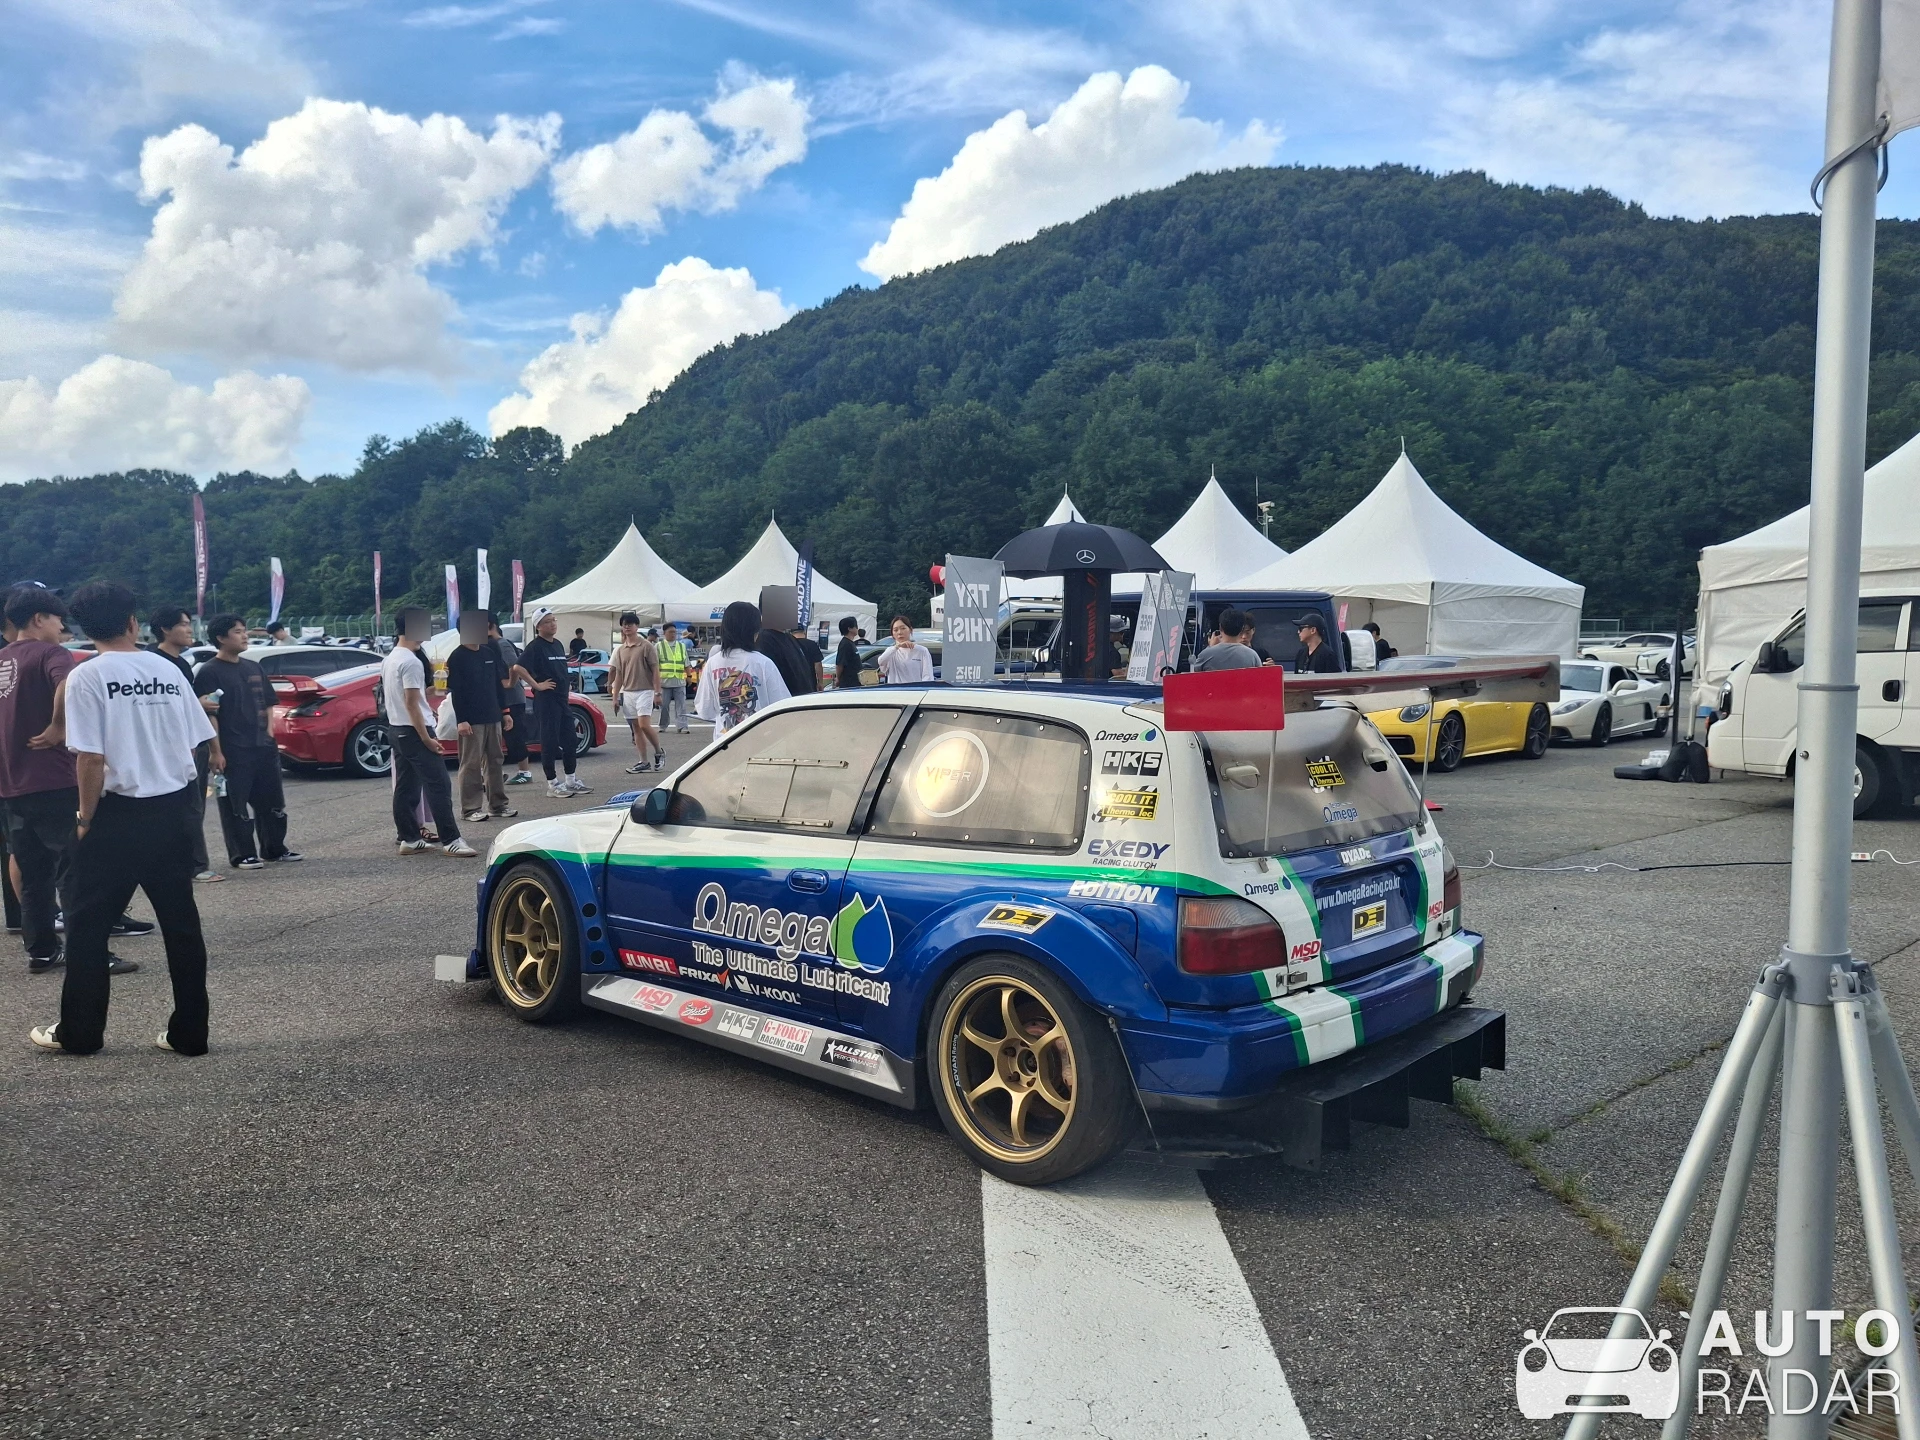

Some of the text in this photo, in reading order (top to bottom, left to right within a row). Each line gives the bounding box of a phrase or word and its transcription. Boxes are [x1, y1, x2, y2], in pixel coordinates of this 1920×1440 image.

[1102, 751, 1162, 771] HKS
[1310, 765, 1328, 775] COOL
[926, 766, 972, 783] VIPER
[1109, 793, 1137, 804] COOL
[1087, 839, 1171, 859] EXEDY
[1092, 858, 1157, 869] RACING CLUTCH
[1068, 880, 1160, 904] EDITION
[1428, 900, 1443, 917] MSD
[1291, 941, 1320, 959] MSD
[679, 966, 723, 985] FRIXA
[692, 942, 891, 1006] The Ultimate Lubricant
[634, 986, 674, 1007] MSD
[720, 1010, 758, 1032] HKS
[764, 1019, 809, 1044] G-FORCE
[760, 1034, 804, 1053] RACING GEAR
[835, 1044, 880, 1061] ALLSTAR
[833, 1053, 877, 1069] PERFORMANCE
[951, 1034, 961, 1087] ADVAN Racing
